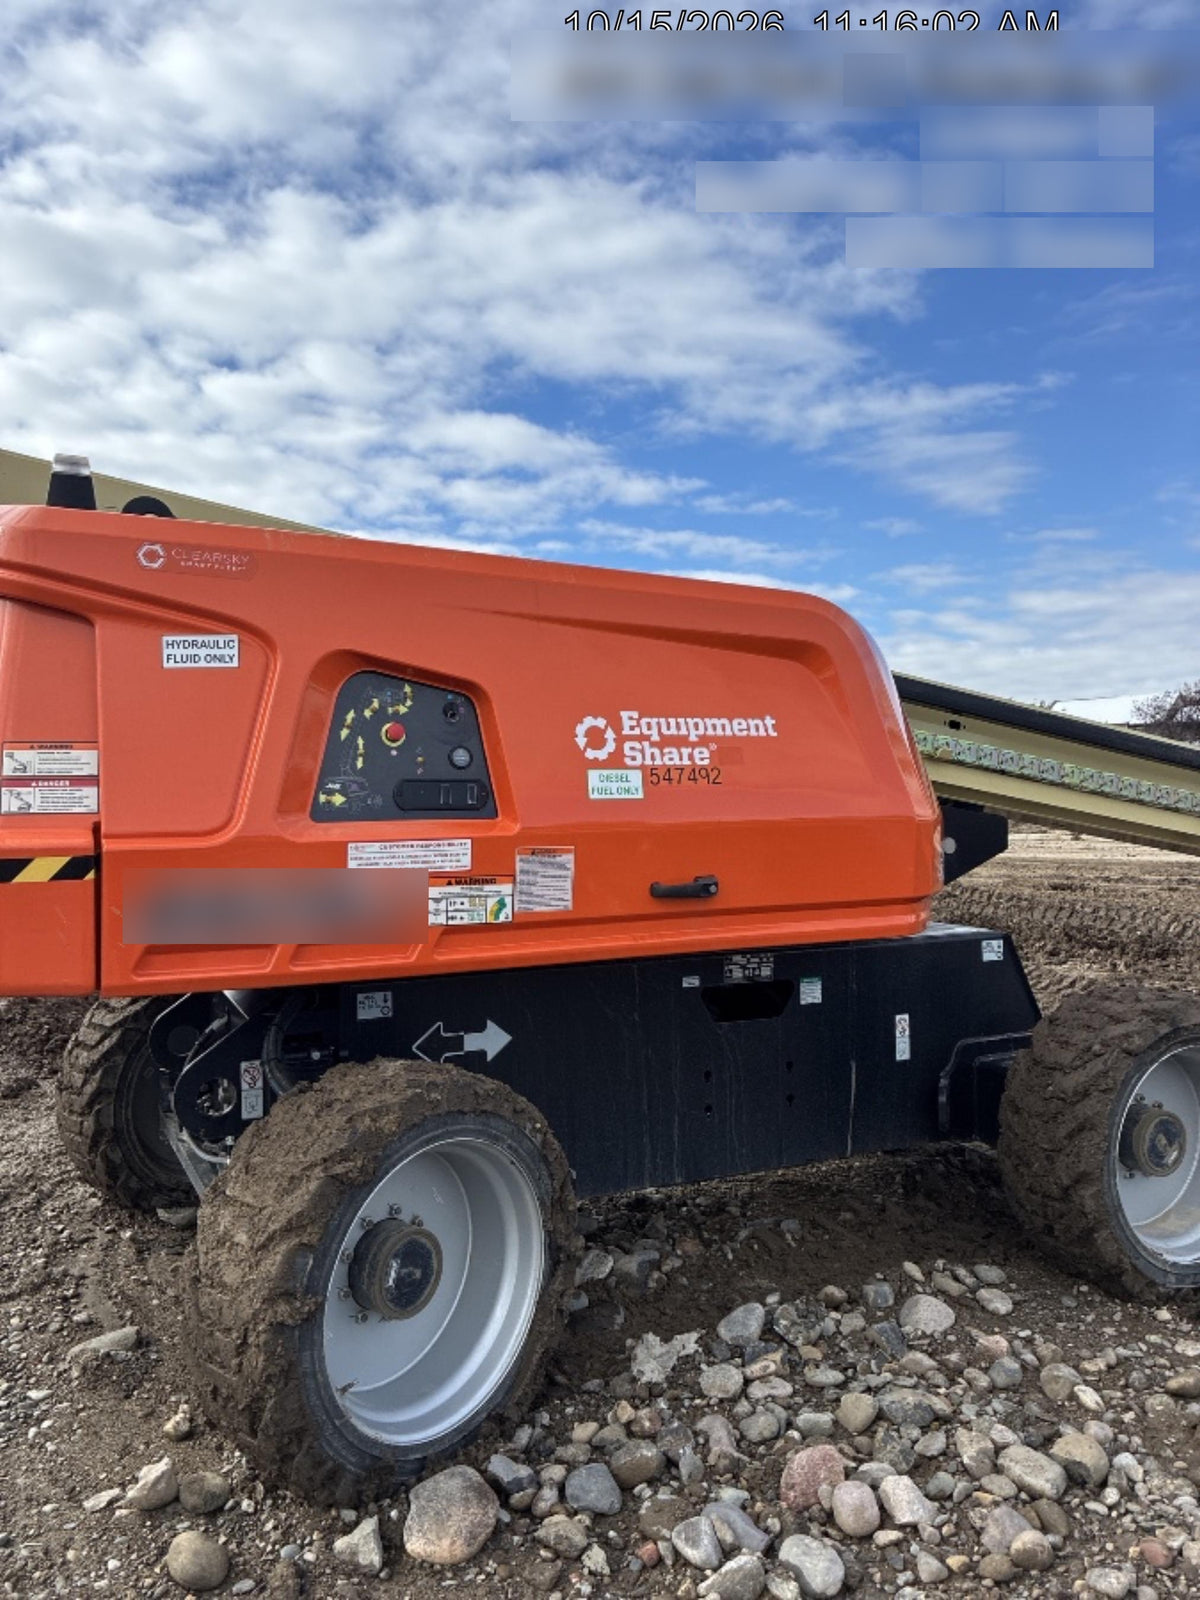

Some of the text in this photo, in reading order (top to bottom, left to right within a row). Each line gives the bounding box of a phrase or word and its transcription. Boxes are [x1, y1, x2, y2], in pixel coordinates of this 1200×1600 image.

[171, 548, 250, 565] CLEARSKY
[166, 640, 235, 650] HYDRAULIC
[166, 653, 235, 664] FLUID ONLY
[620, 711, 778, 741] Equipment
[598, 773, 632, 783] DIESEL
[650, 767, 722, 785] 547492
[591, 786, 640, 796] FUEL ONLY
